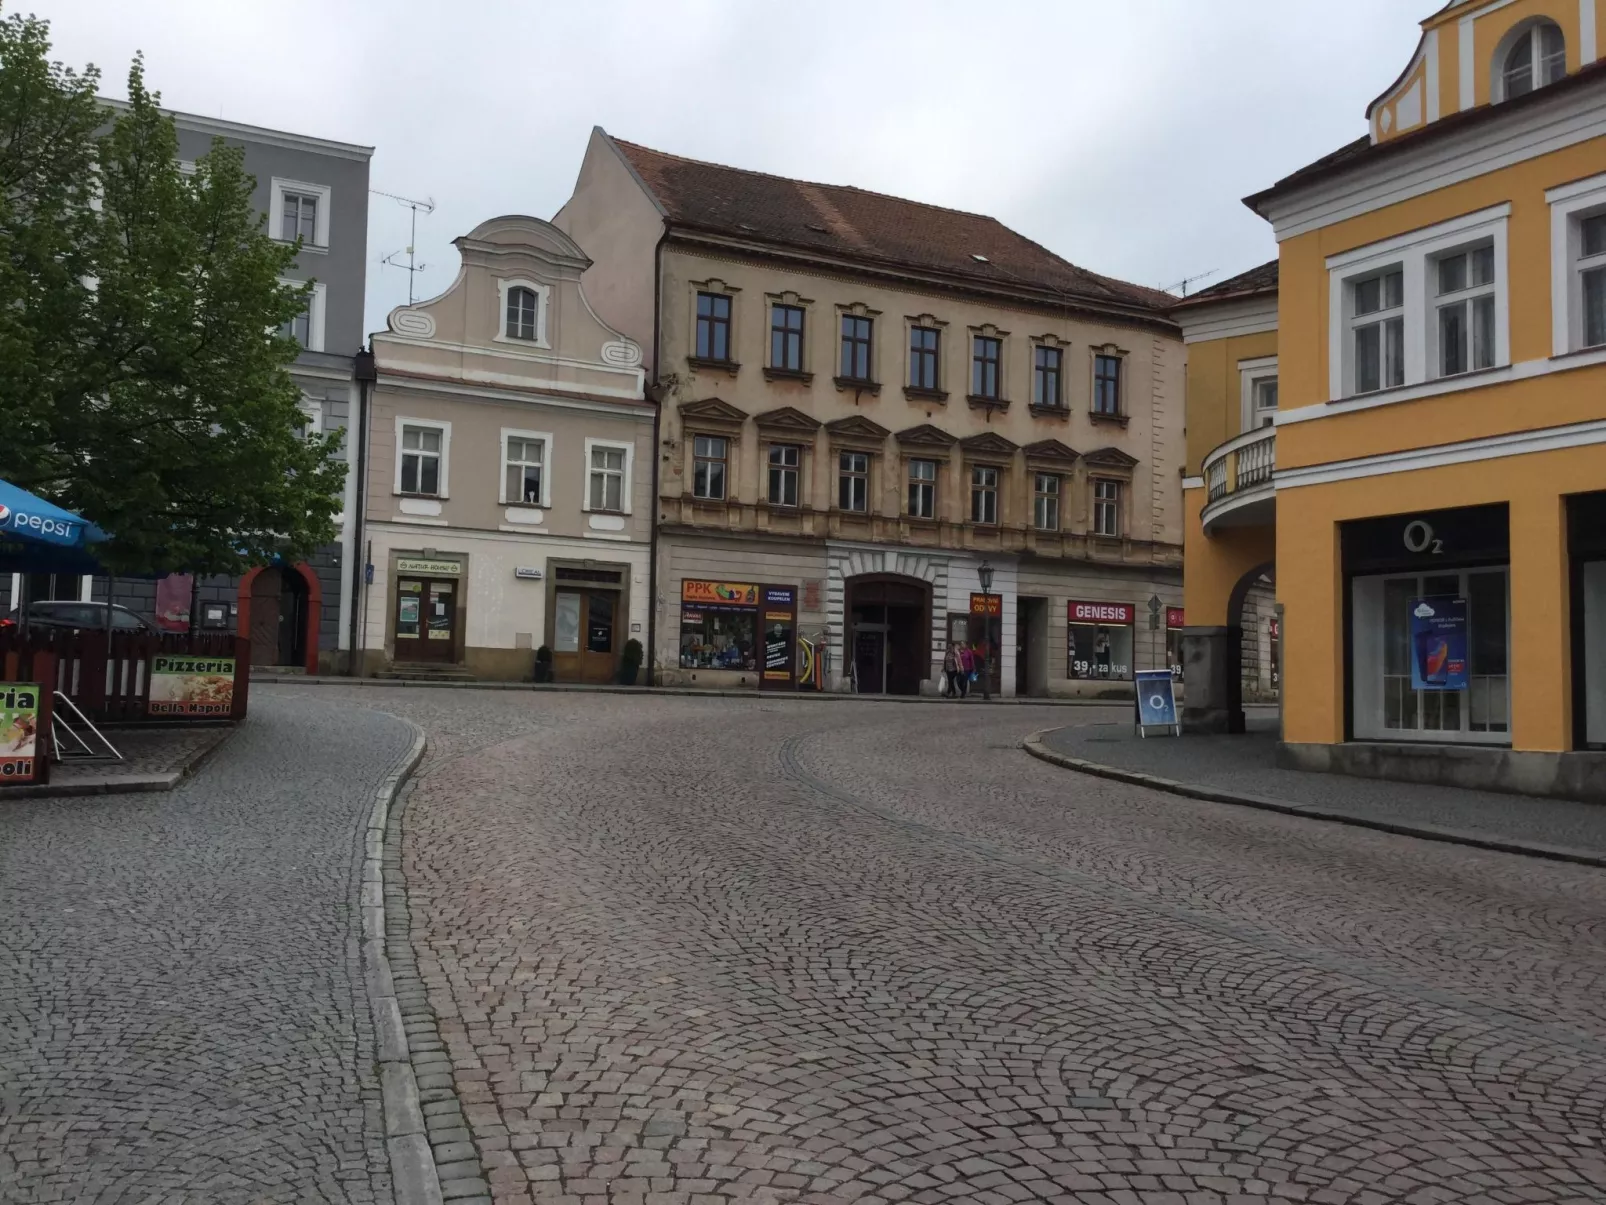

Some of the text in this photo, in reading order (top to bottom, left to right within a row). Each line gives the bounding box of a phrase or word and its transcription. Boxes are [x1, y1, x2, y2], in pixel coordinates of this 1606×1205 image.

[14, 512, 73, 537] pepsi
[686, 582, 712, 594] PPK
[973, 604, 997, 613] ODVY
[1076, 605, 1126, 620] GENESIS
[155, 658, 233, 673] Pizzeria
[1098, 664, 1109, 673] za
[1111, 661, 1128, 673] kus
[151, 703, 230, 714] Bella Napoli
